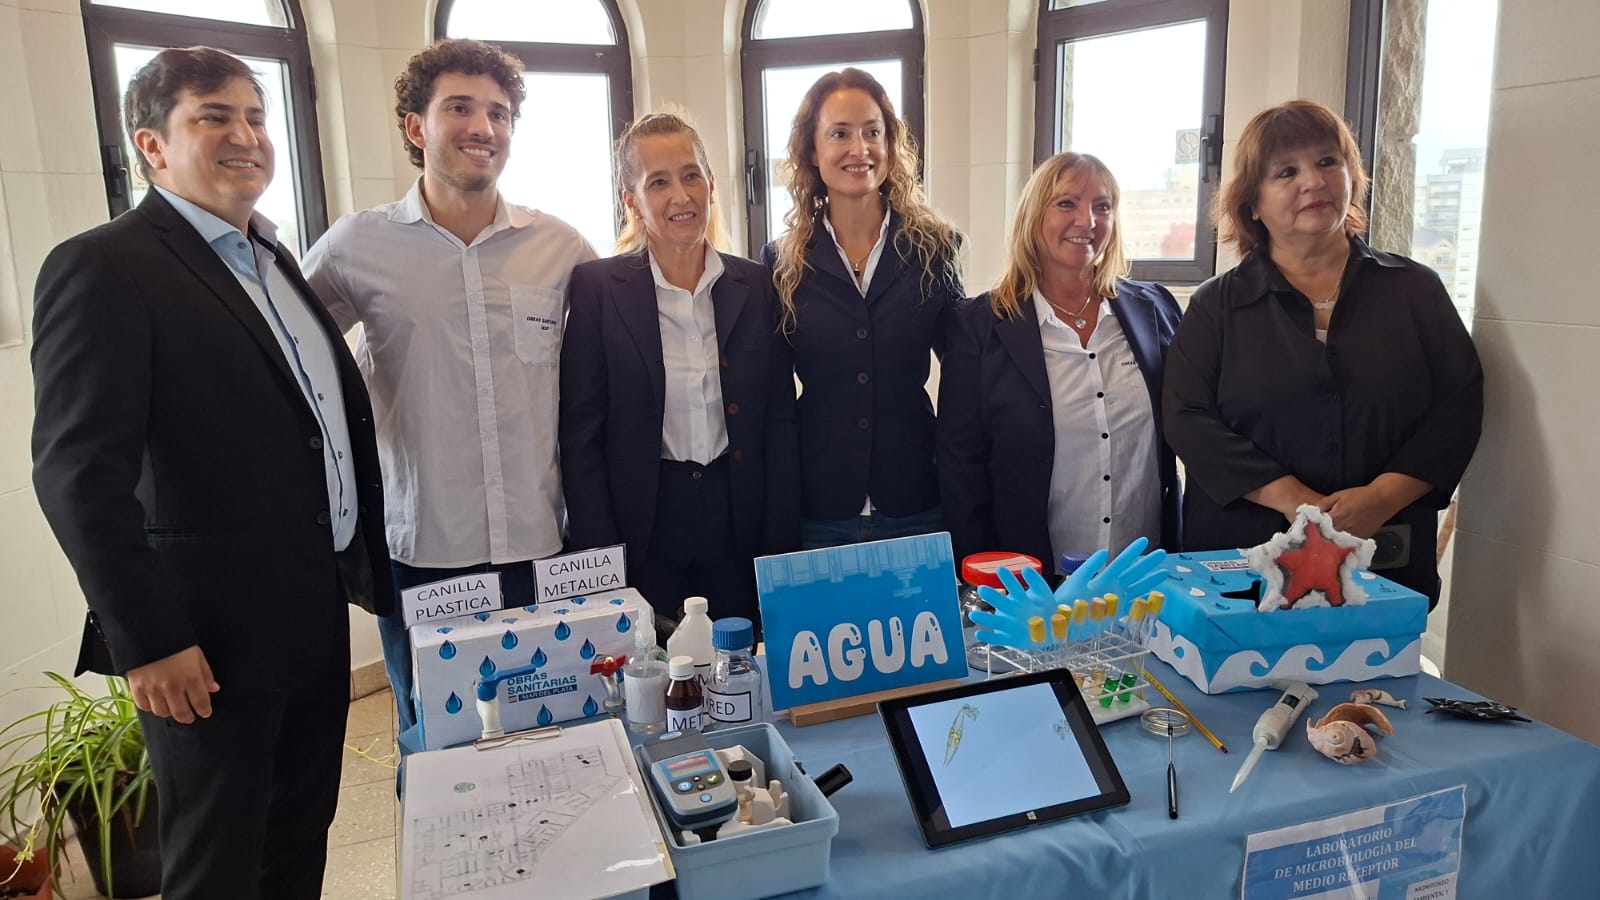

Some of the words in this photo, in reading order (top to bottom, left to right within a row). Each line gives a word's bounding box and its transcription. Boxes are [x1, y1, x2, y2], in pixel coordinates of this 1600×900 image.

[549, 554, 611, 577] CANILLA
[416, 579, 487, 602] CANILLA
[544, 573, 620, 598] METALICA
[415, 596, 492, 620] PLASTICA
[788, 611, 948, 689] AGUA
[507, 672, 548, 686] OBRAS
[507, 675, 577, 695] SANITARIAS
[522, 692, 538, 700] MAR
[538, 689, 553, 697] DEL
[553, 686, 574, 695] PLATA
[1306, 827, 1393, 858] LABORATORIO
[1274, 866, 1293, 880] DE
[1395, 837, 1417, 851] DEL
[1293, 874, 1335, 893] MEDIO
[1338, 857, 1400, 883] RECEPTOR
